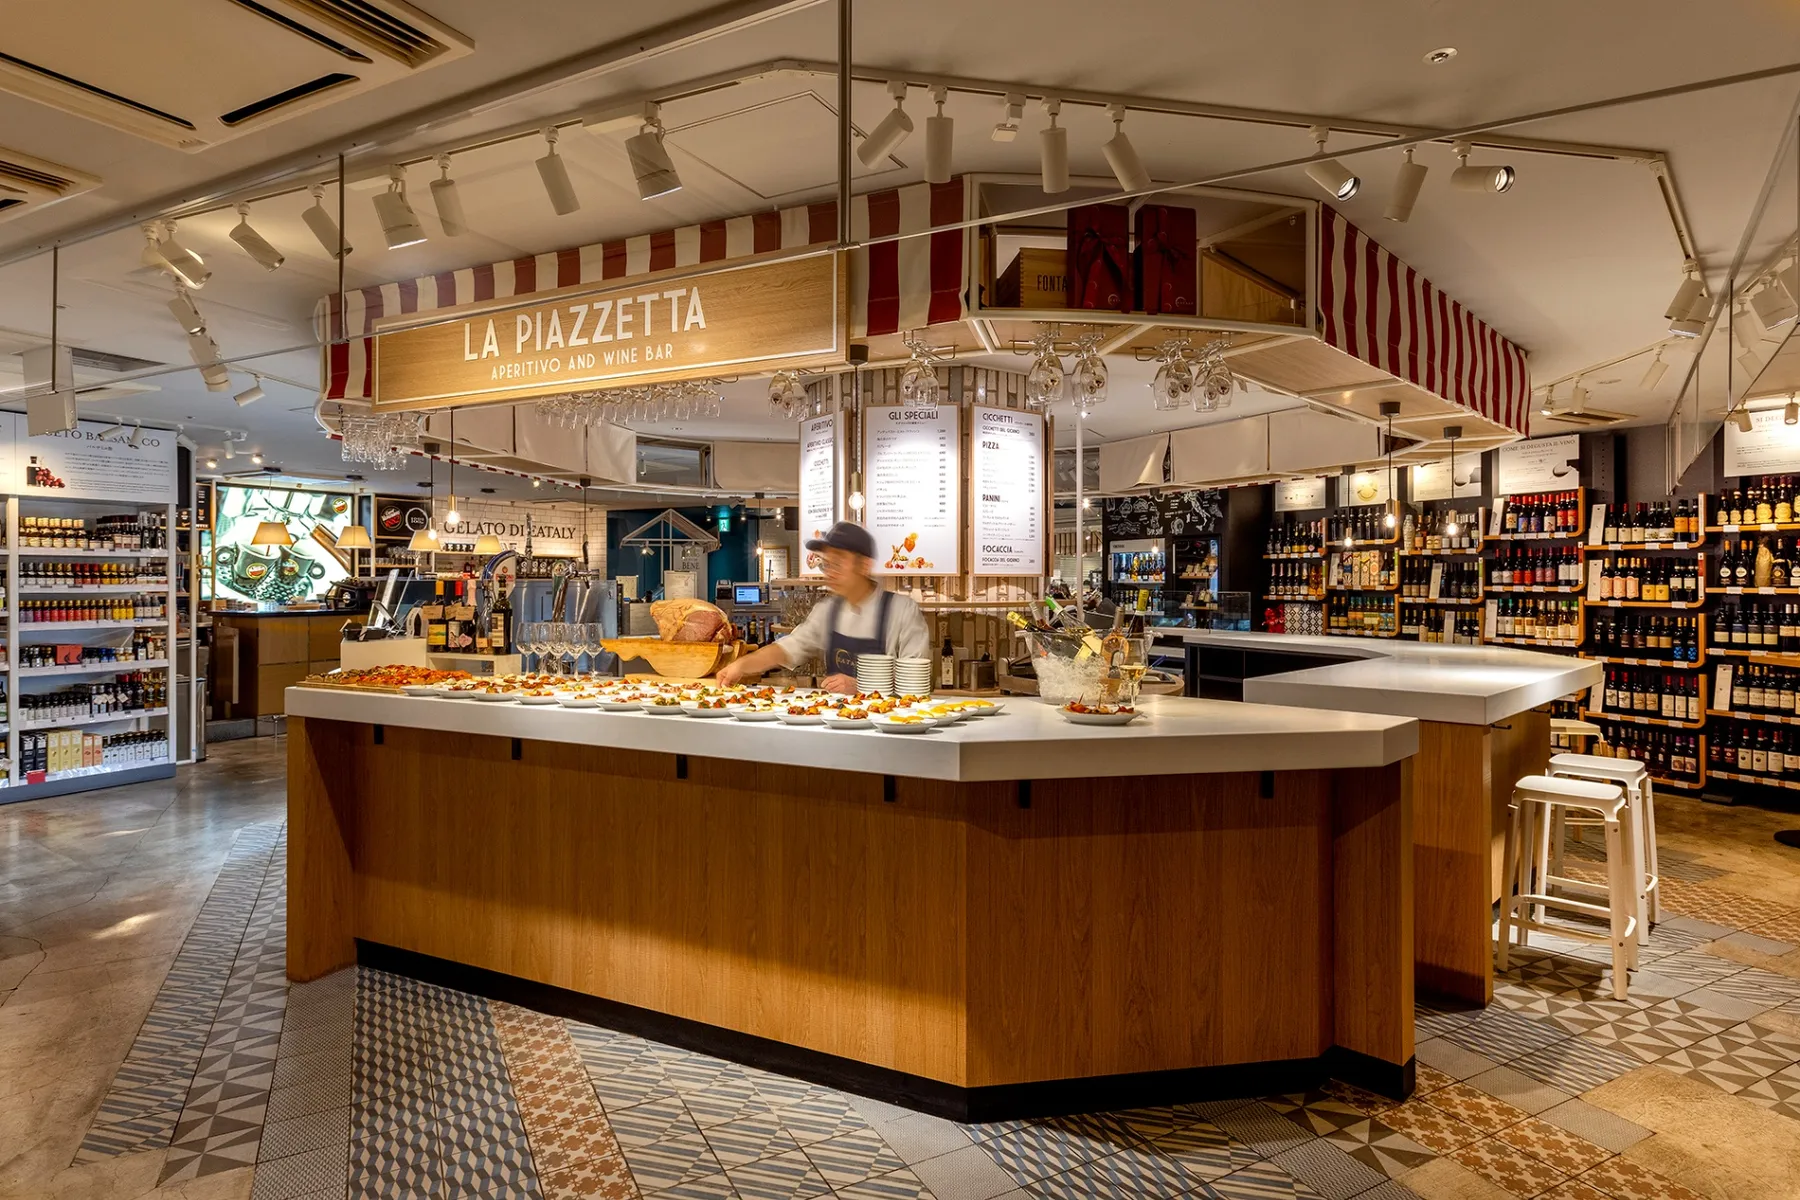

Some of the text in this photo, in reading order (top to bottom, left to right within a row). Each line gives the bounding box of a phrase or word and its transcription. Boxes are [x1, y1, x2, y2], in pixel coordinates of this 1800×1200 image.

[464, 286, 707, 361] LA PIAZZETTA
[491, 343, 674, 381] APERITIVO AND WINE BAR
[888, 410, 939, 421] GLI SPECIALI
[982, 412, 1013, 424] CICCHETTI
[982, 440, 999, 450] PIZZA
[982, 493, 1000, 503] PANINI
[443, 520, 576, 539] GELATO DI EATALY
[982, 545, 1013, 553] FOCACCIA
[682, 561, 700, 570] BENE
